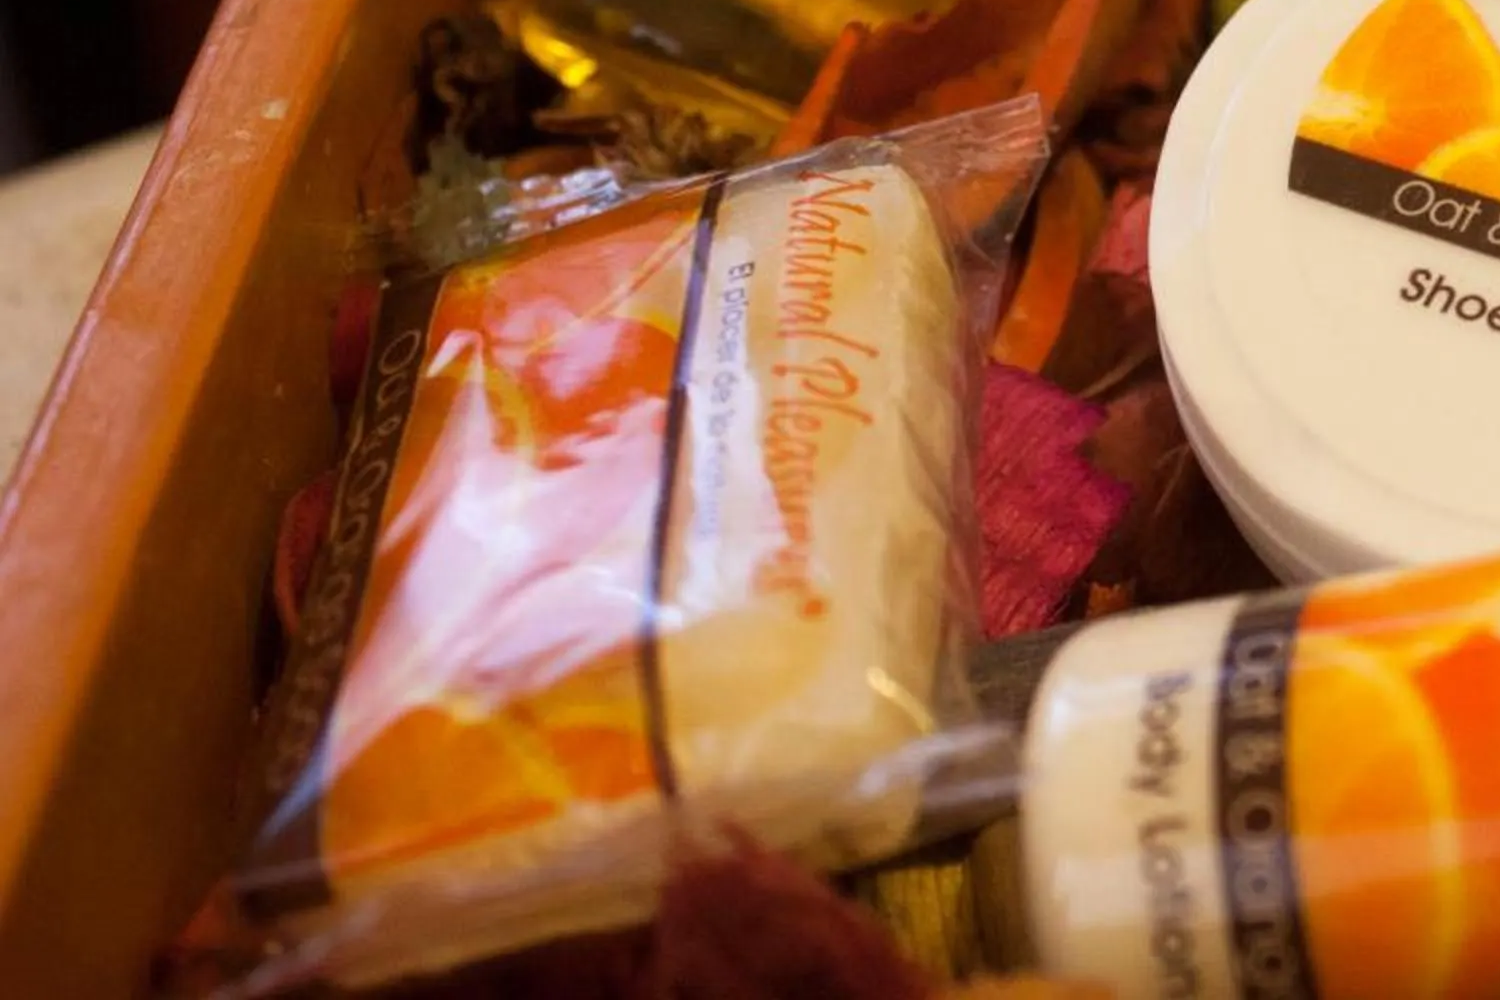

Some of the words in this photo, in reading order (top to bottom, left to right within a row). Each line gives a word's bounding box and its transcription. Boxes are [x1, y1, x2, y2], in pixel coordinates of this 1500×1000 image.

[777, 169, 881, 359] Natural
[1392, 180, 1482, 232] Oat
[1126, 672, 1196, 798] Body
